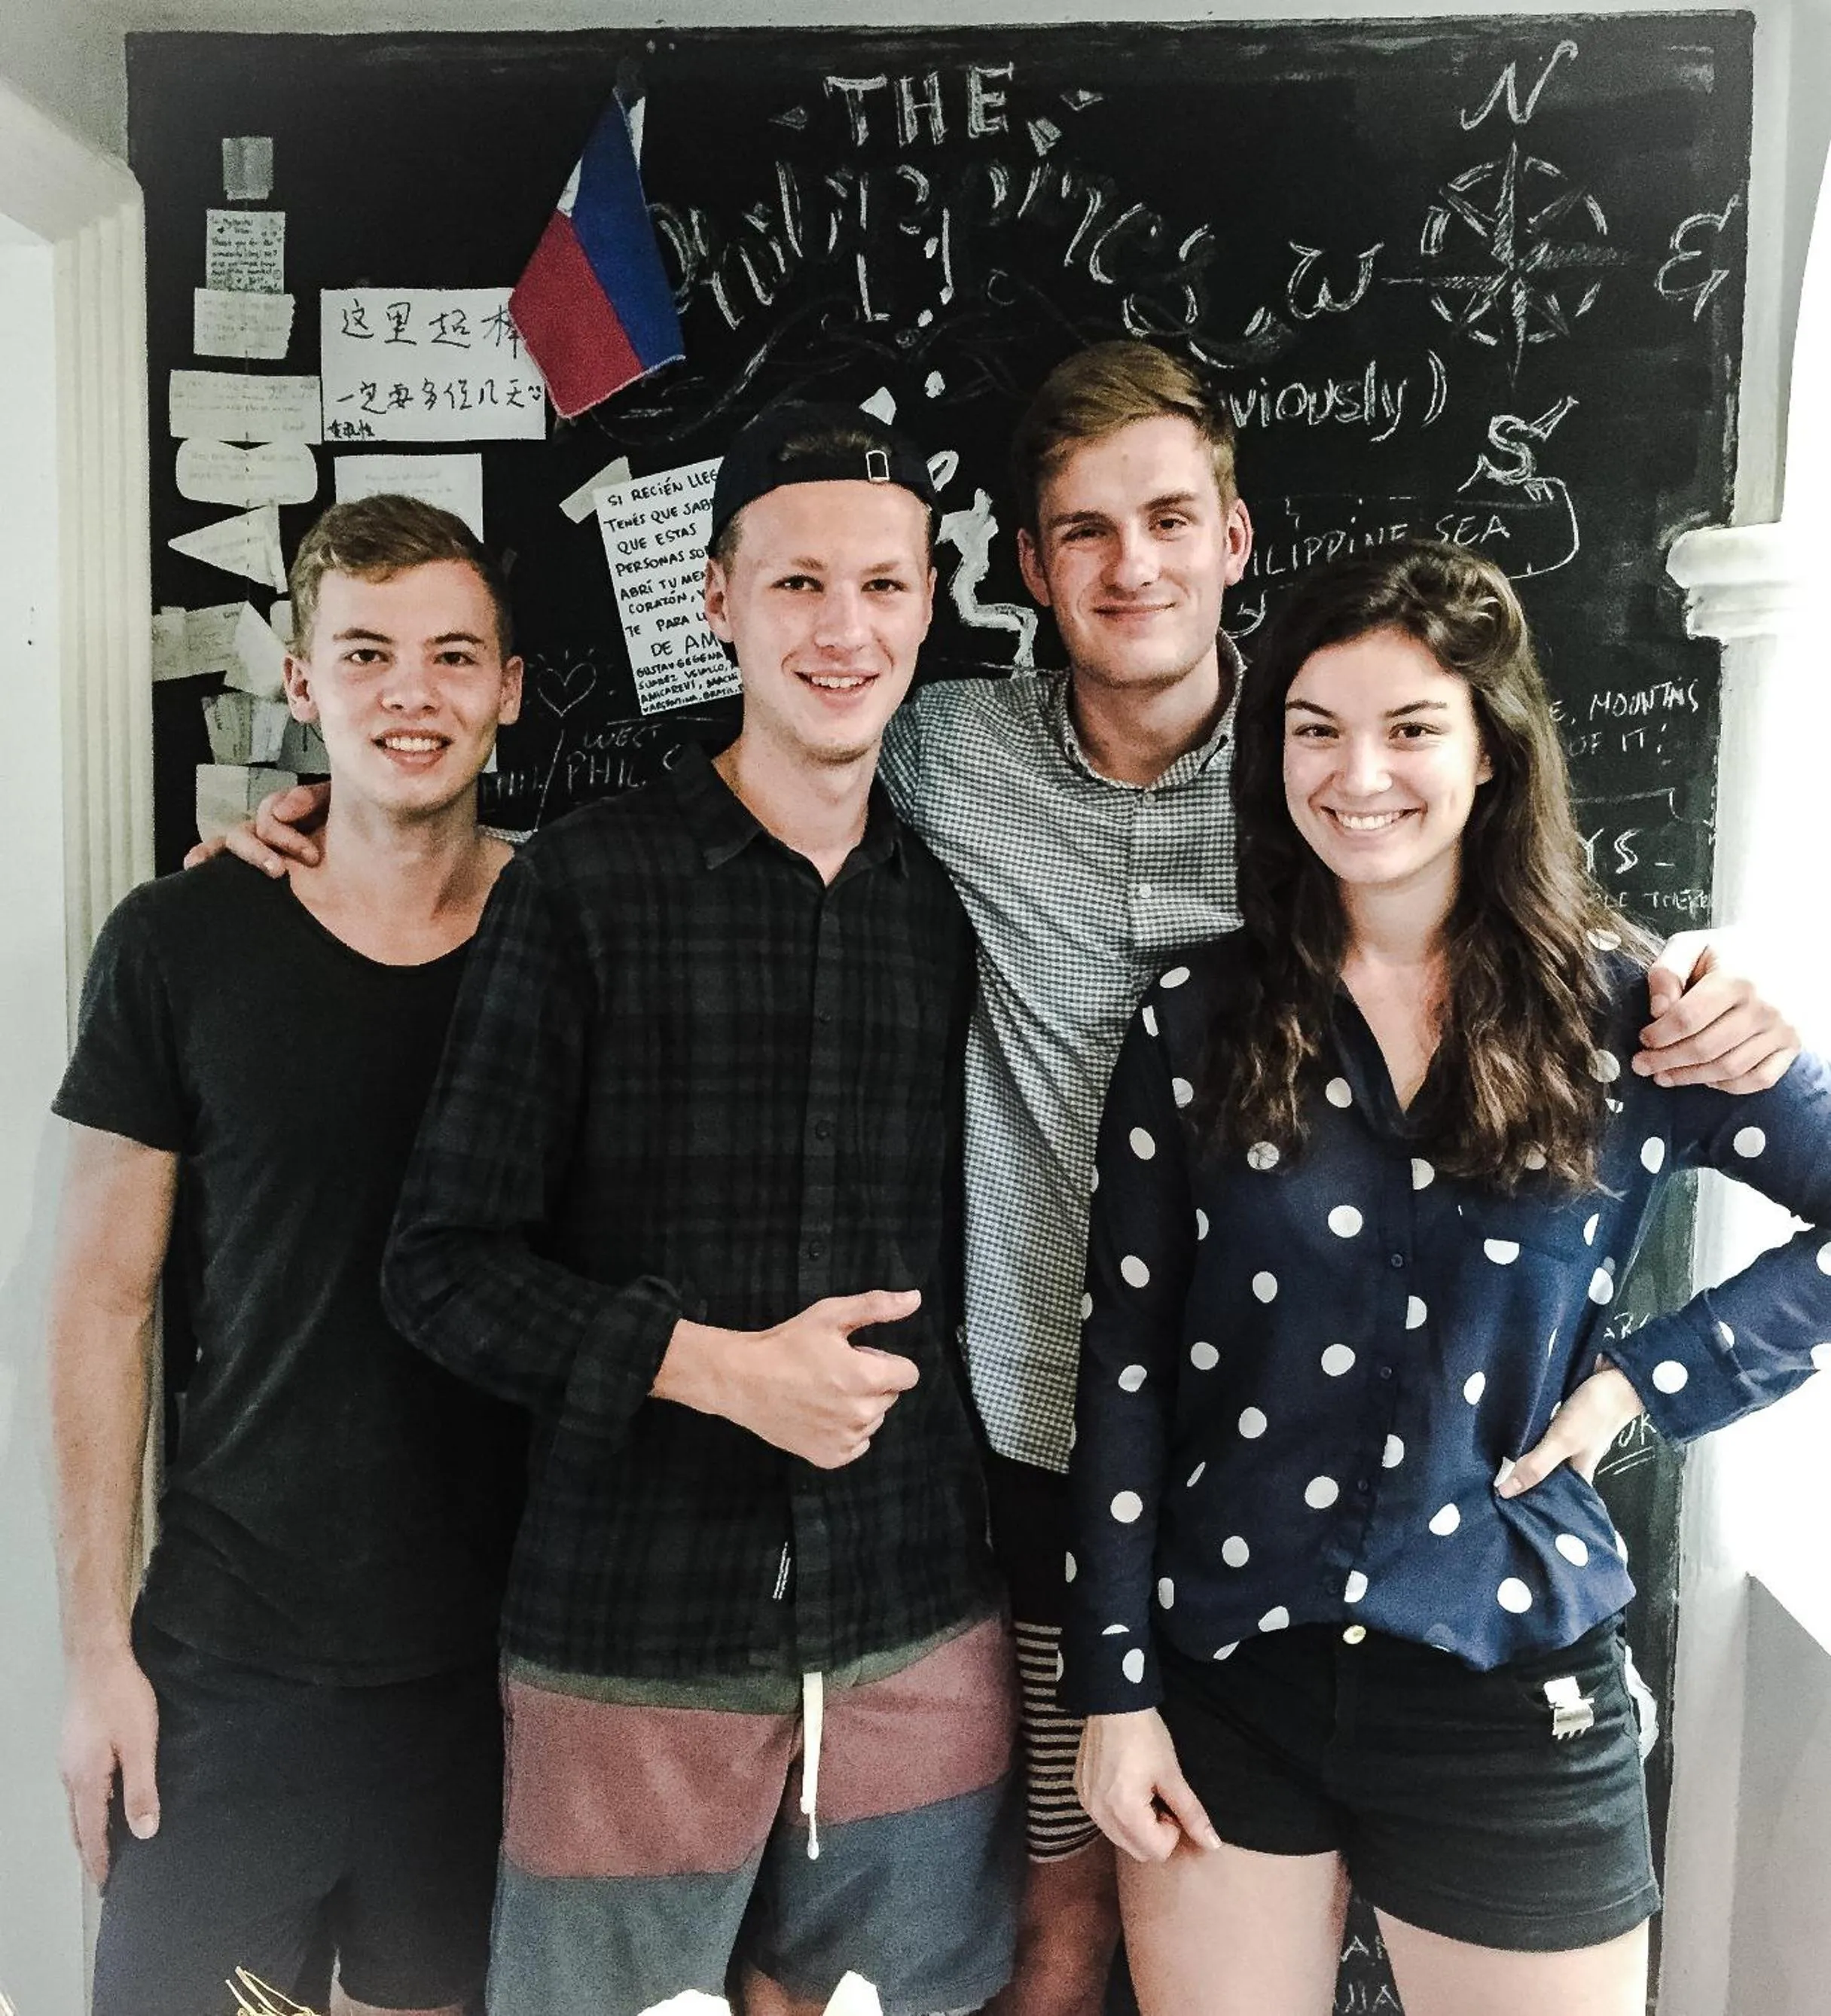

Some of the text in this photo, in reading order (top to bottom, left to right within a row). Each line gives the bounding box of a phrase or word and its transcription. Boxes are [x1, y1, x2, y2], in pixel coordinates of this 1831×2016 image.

[1460, 39, 1579, 132] N
[824, 62, 1015, 147] THE
[1655, 194, 1744, 322] E
[1219, 349, 1447, 442] viously)
[1457, 395, 1580, 494] S
[608, 494, 623, 506] SI
[651, 506, 679, 525] QUE
[683, 498, 715, 516] SAB
[618, 523, 697, 555] QUE ESTAS
[1253, 514, 1511, 576] ILIPPINE SEA
[615, 550, 685, 577] PERSONAS
[659, 578, 676, 590] TU
[656, 616, 690, 631] PARA
[651, 642, 673, 657] DE
